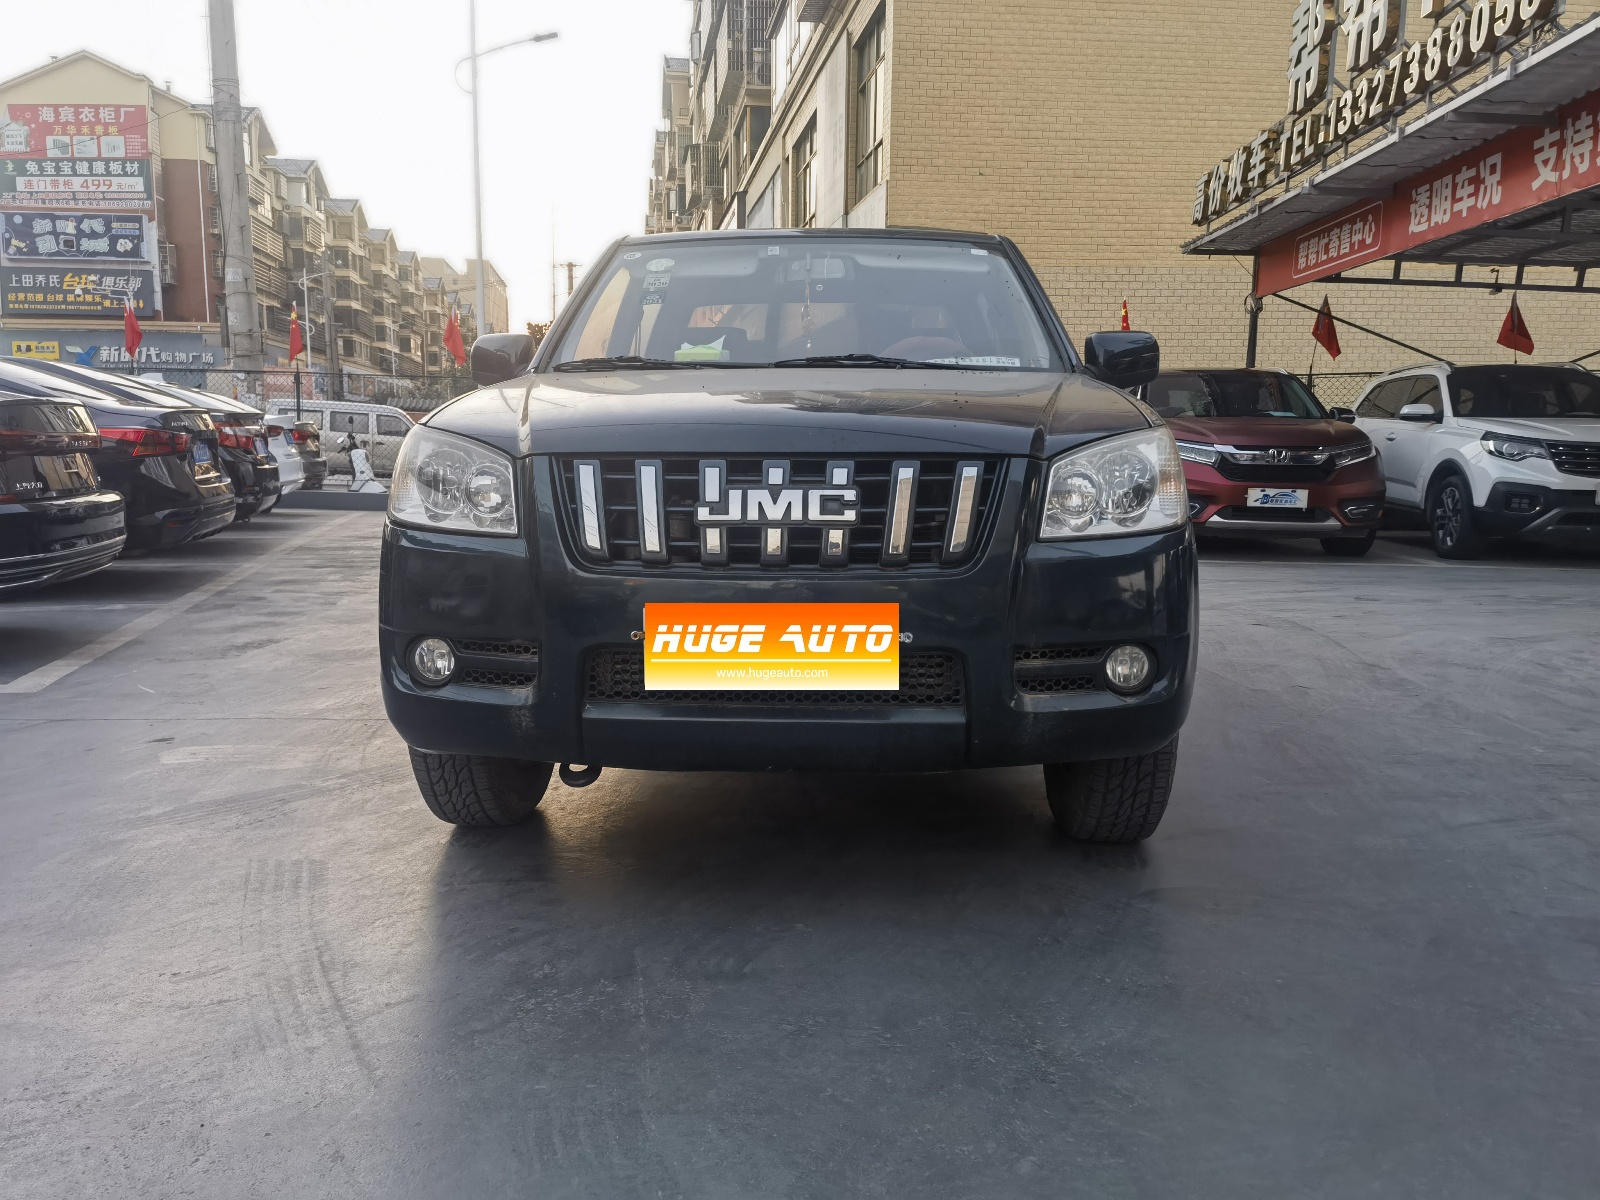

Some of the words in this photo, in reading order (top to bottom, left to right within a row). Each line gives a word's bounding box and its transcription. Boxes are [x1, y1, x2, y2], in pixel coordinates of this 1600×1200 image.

[23, 179, 75, 190] 连门带柜
[80, 179, 113, 190] 499
[25, 161, 140, 176] 兔宝宝健康板材
[1192, 131, 1269, 225] 高价收车
[1298, 213, 1376, 270] 帮帮忙寄售中心
[1409, 152, 1502, 236] 透明车况
[1531, 111, 1600, 191] 支持
[697, 489, 857, 521] JMC
